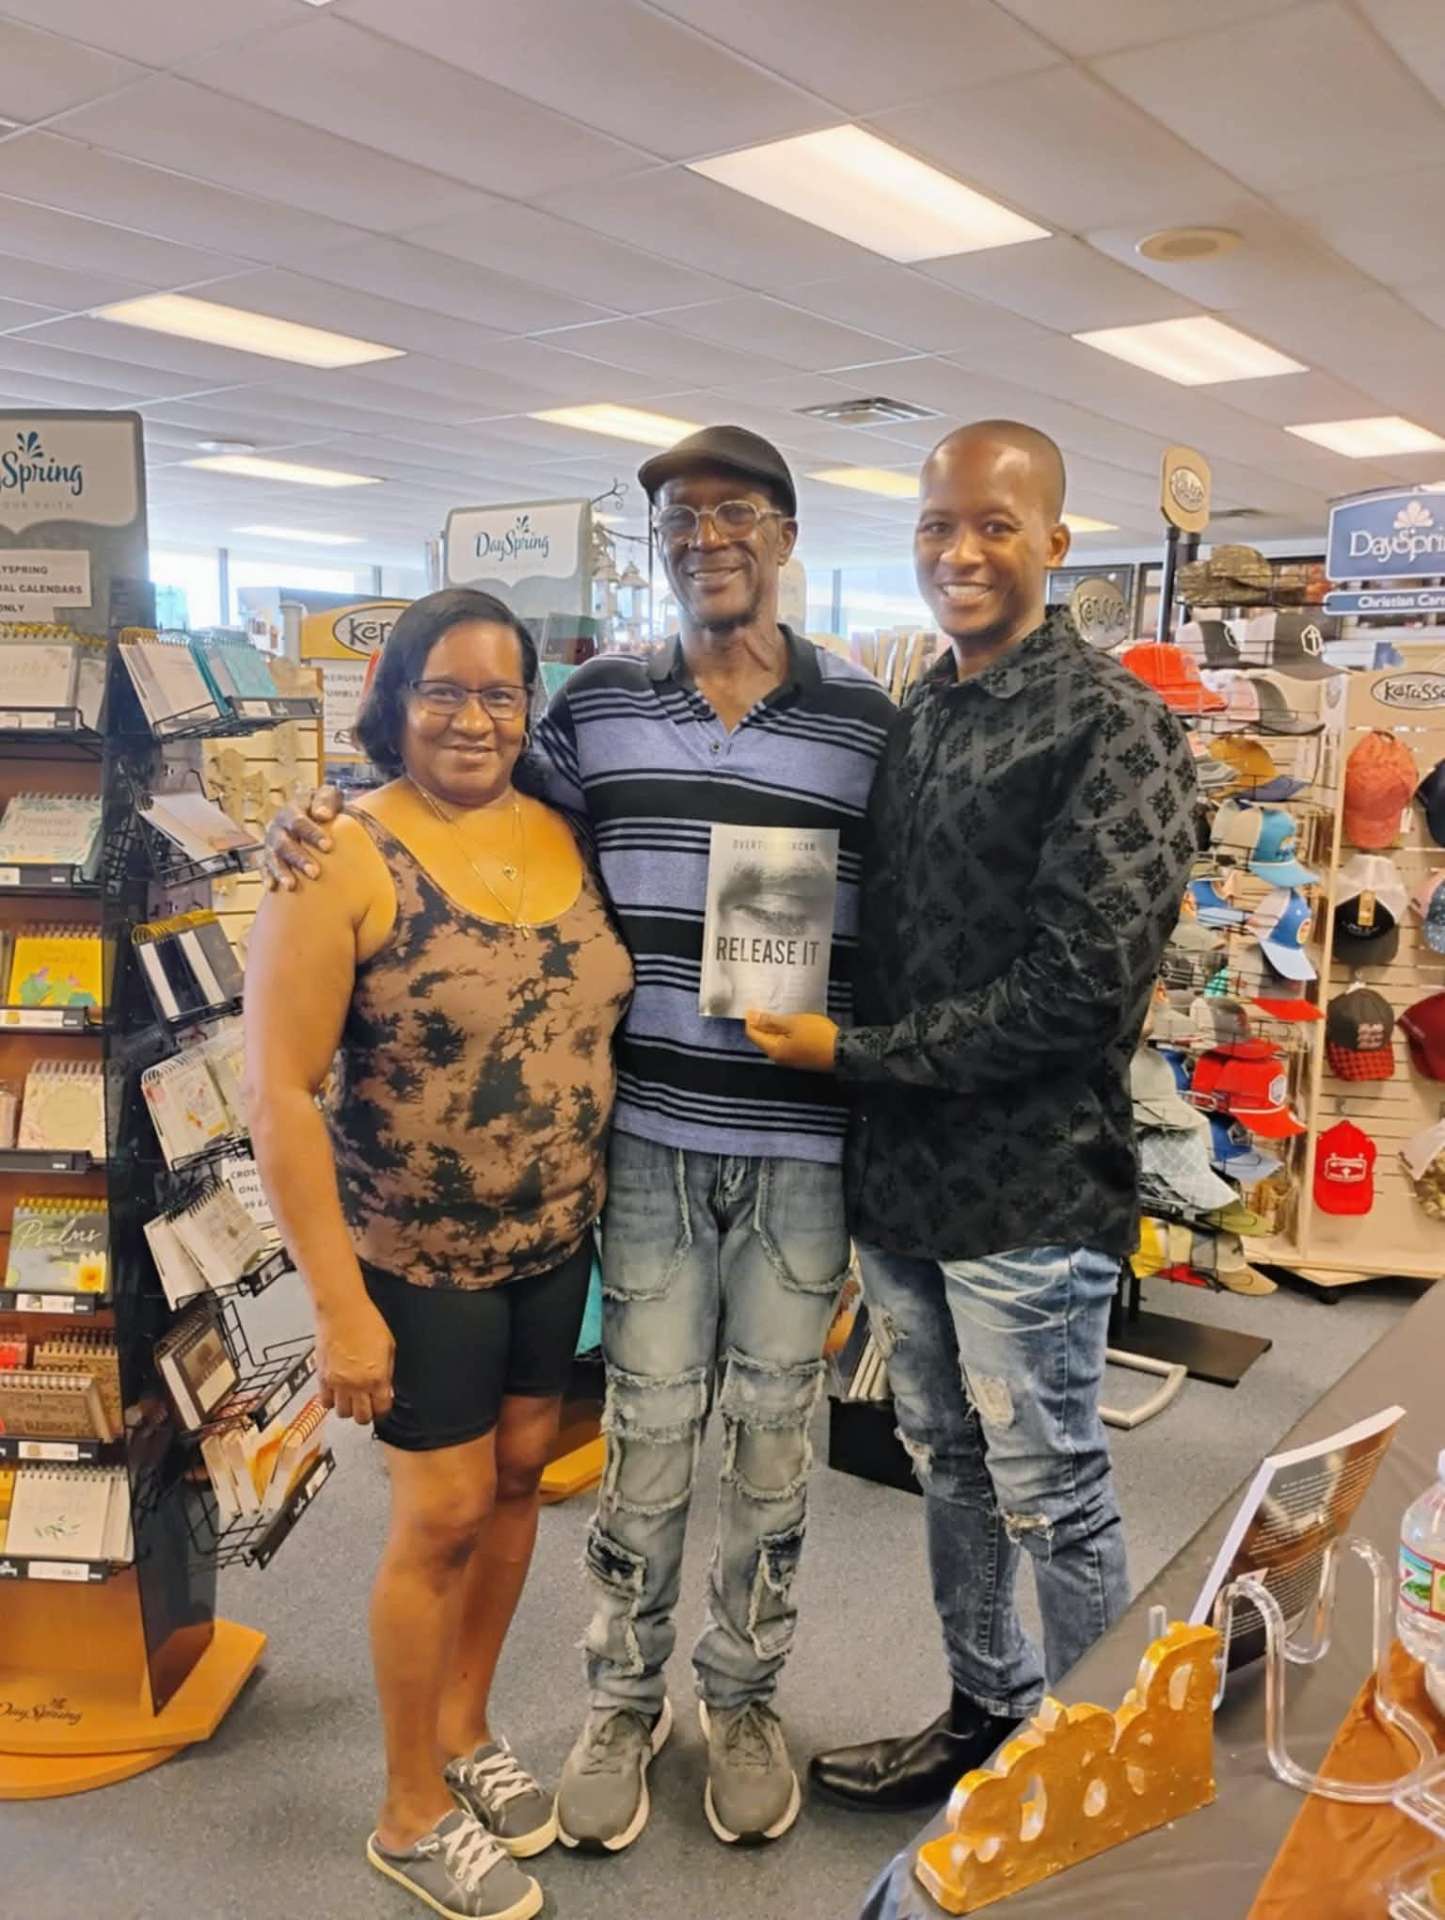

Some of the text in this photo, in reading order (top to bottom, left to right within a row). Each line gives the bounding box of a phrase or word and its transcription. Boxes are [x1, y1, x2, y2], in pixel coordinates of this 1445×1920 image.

[0, 451, 83, 496] Spring
[475, 530, 550, 562] DaySpring
[0, 565, 49, 575] YSPRING
[18, 584, 83, 594] CALENDARS
[1358, 595, 1415, 609] Christian
[716, 937, 820, 966] RELEASE IT
[15, 1218, 102, 1248] Psalms
